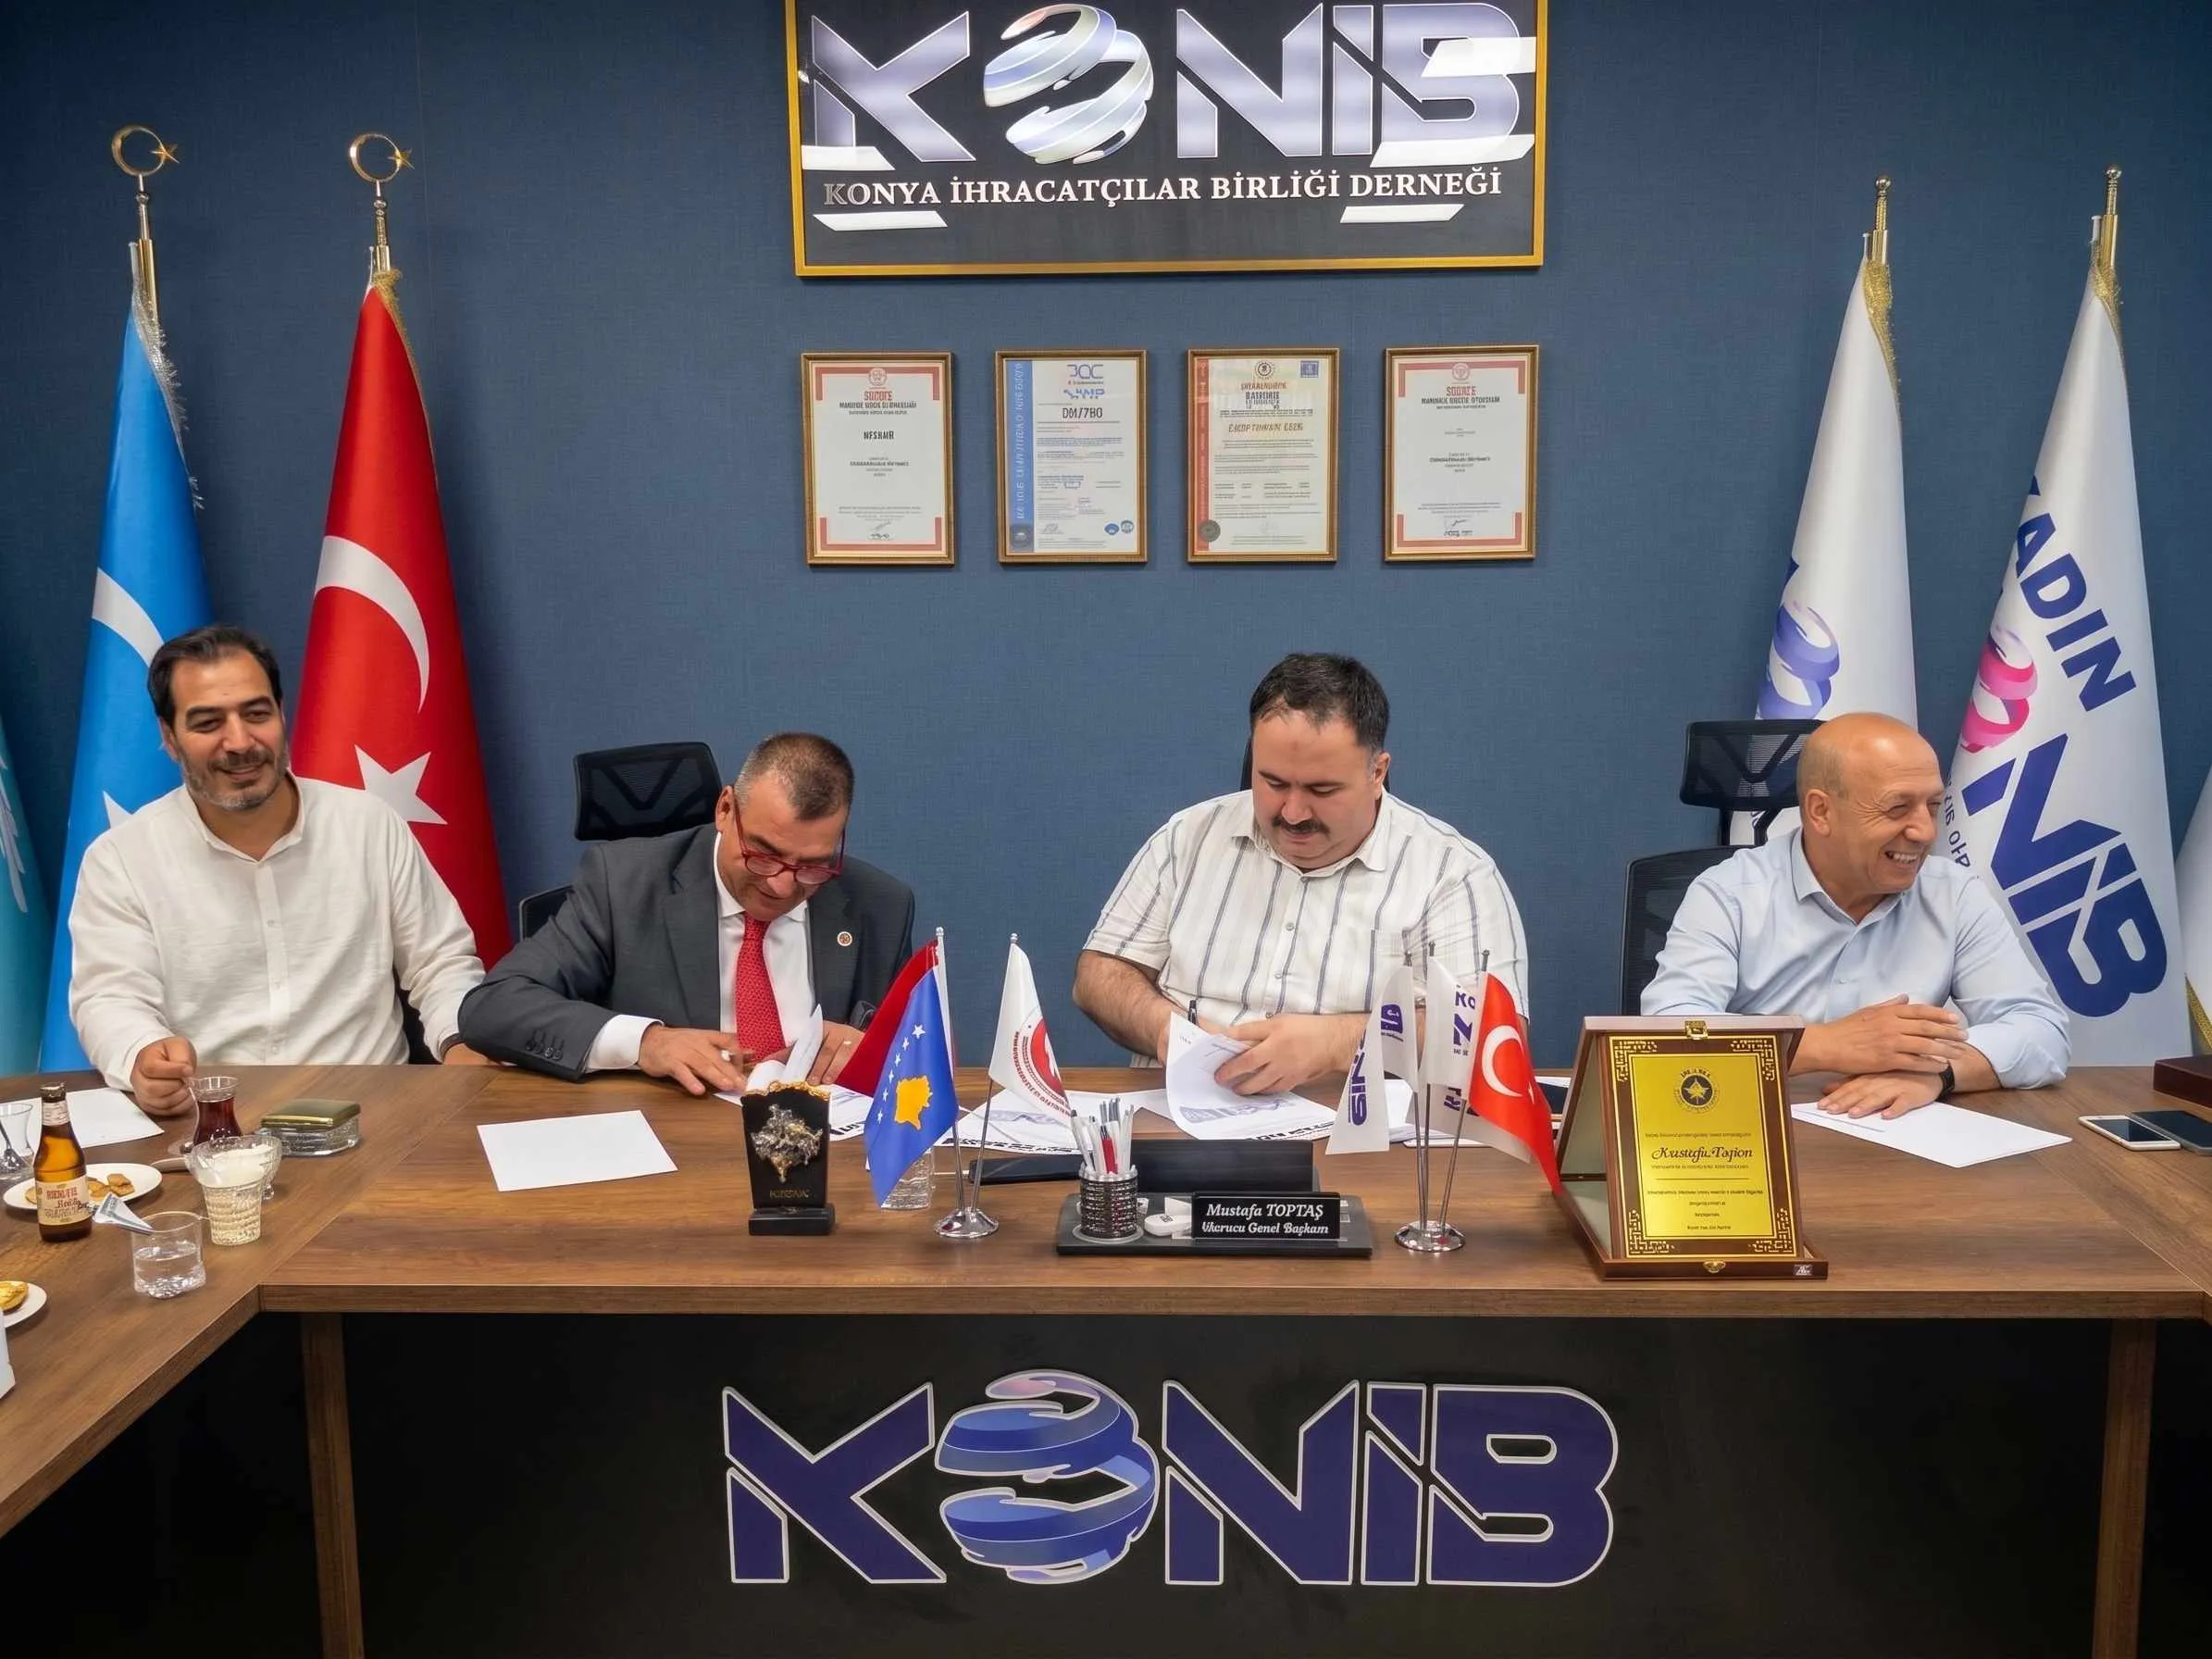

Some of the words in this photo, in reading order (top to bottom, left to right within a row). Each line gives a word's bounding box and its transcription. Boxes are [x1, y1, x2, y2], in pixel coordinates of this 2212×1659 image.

[823, 181, 941, 206] KONYA
[950, 175, 1200, 207] İHRACATÇILAR
[1211, 169, 1340, 200] BİRLİĞİ
[1348, 167, 1502, 197] DERNEĞİ
[1206, 1203, 1263, 1221] Mustafa
[1265, 1203, 1324, 1221] TOPTAŞ
[1248, 1221, 1281, 1234] Genel
